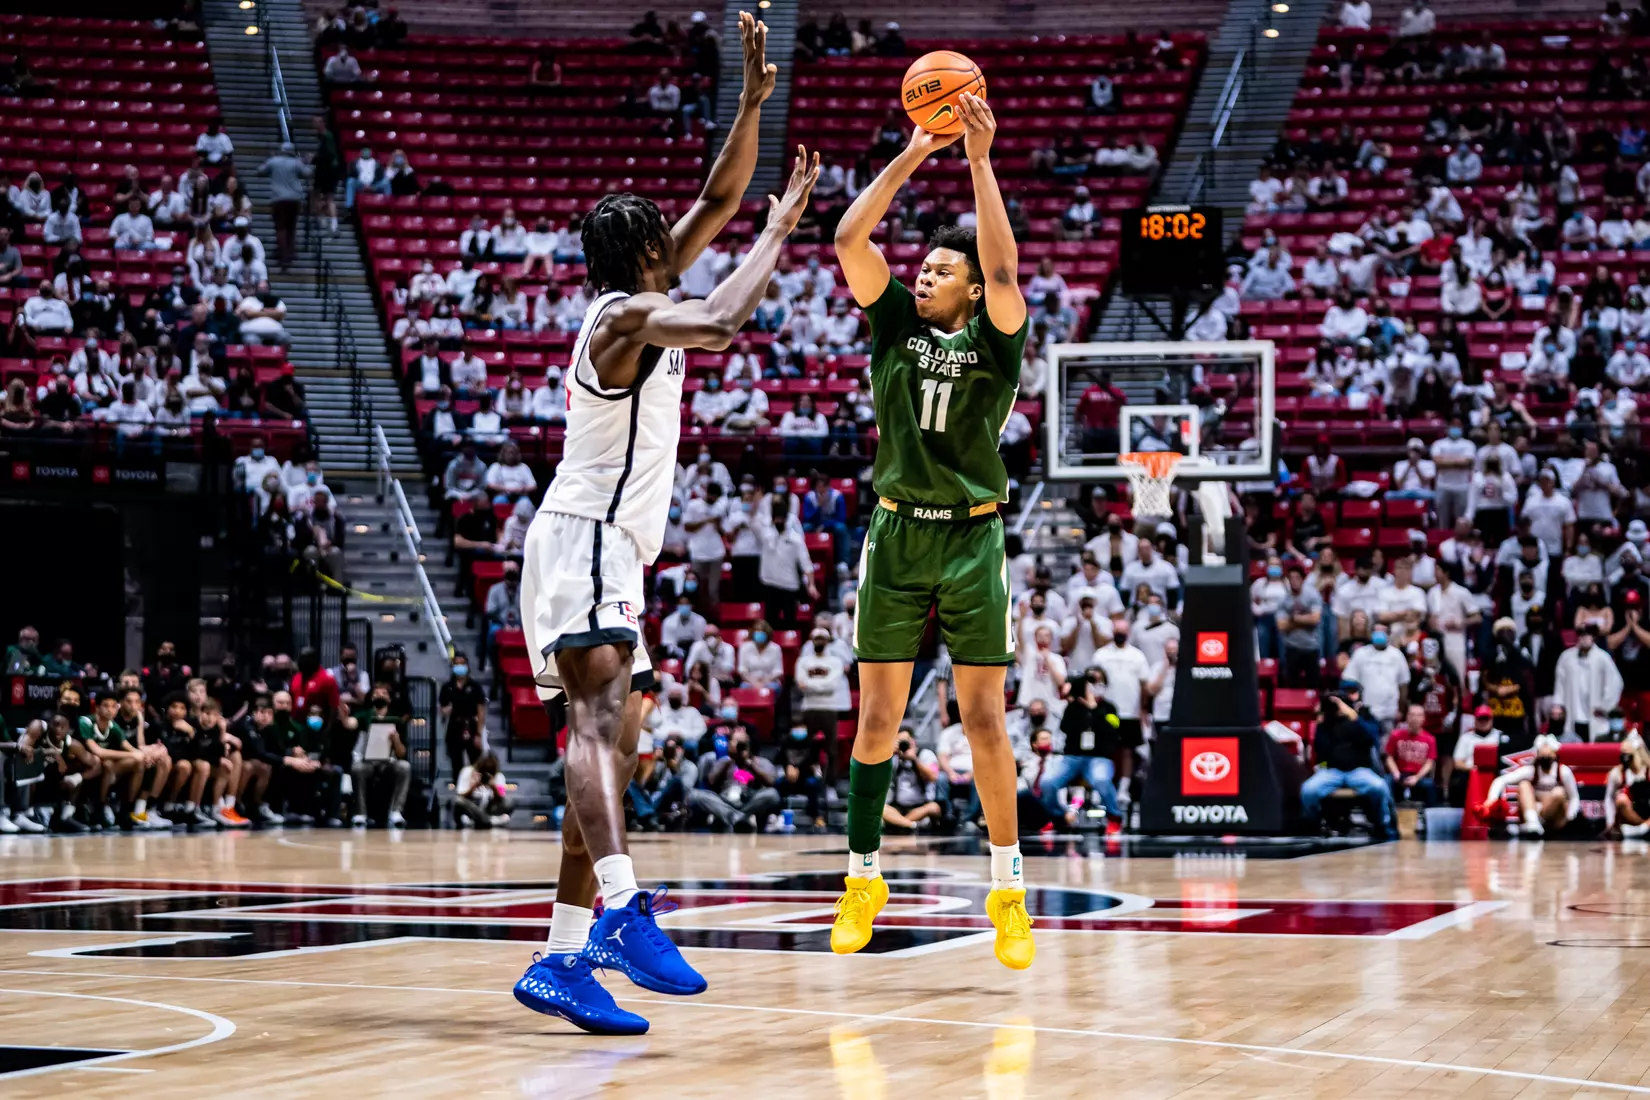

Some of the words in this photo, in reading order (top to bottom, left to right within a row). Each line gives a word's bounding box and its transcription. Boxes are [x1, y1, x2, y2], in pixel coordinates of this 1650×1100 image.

[906, 80, 942, 103] ELITE
[1141, 213, 1206, 240] 18:02
[907, 337, 978, 364] COLOADO
[920, 379, 953, 432] 11
[36, 466, 79, 477] TOYOTA
[115, 469, 158, 481] TOYOTA
[914, 507, 952, 520] RAMS
[1191, 667, 1233, 679] TOYOTA
[28, 684, 59, 699] TOYOT
[1171, 805, 1248, 823] TOYOTA
